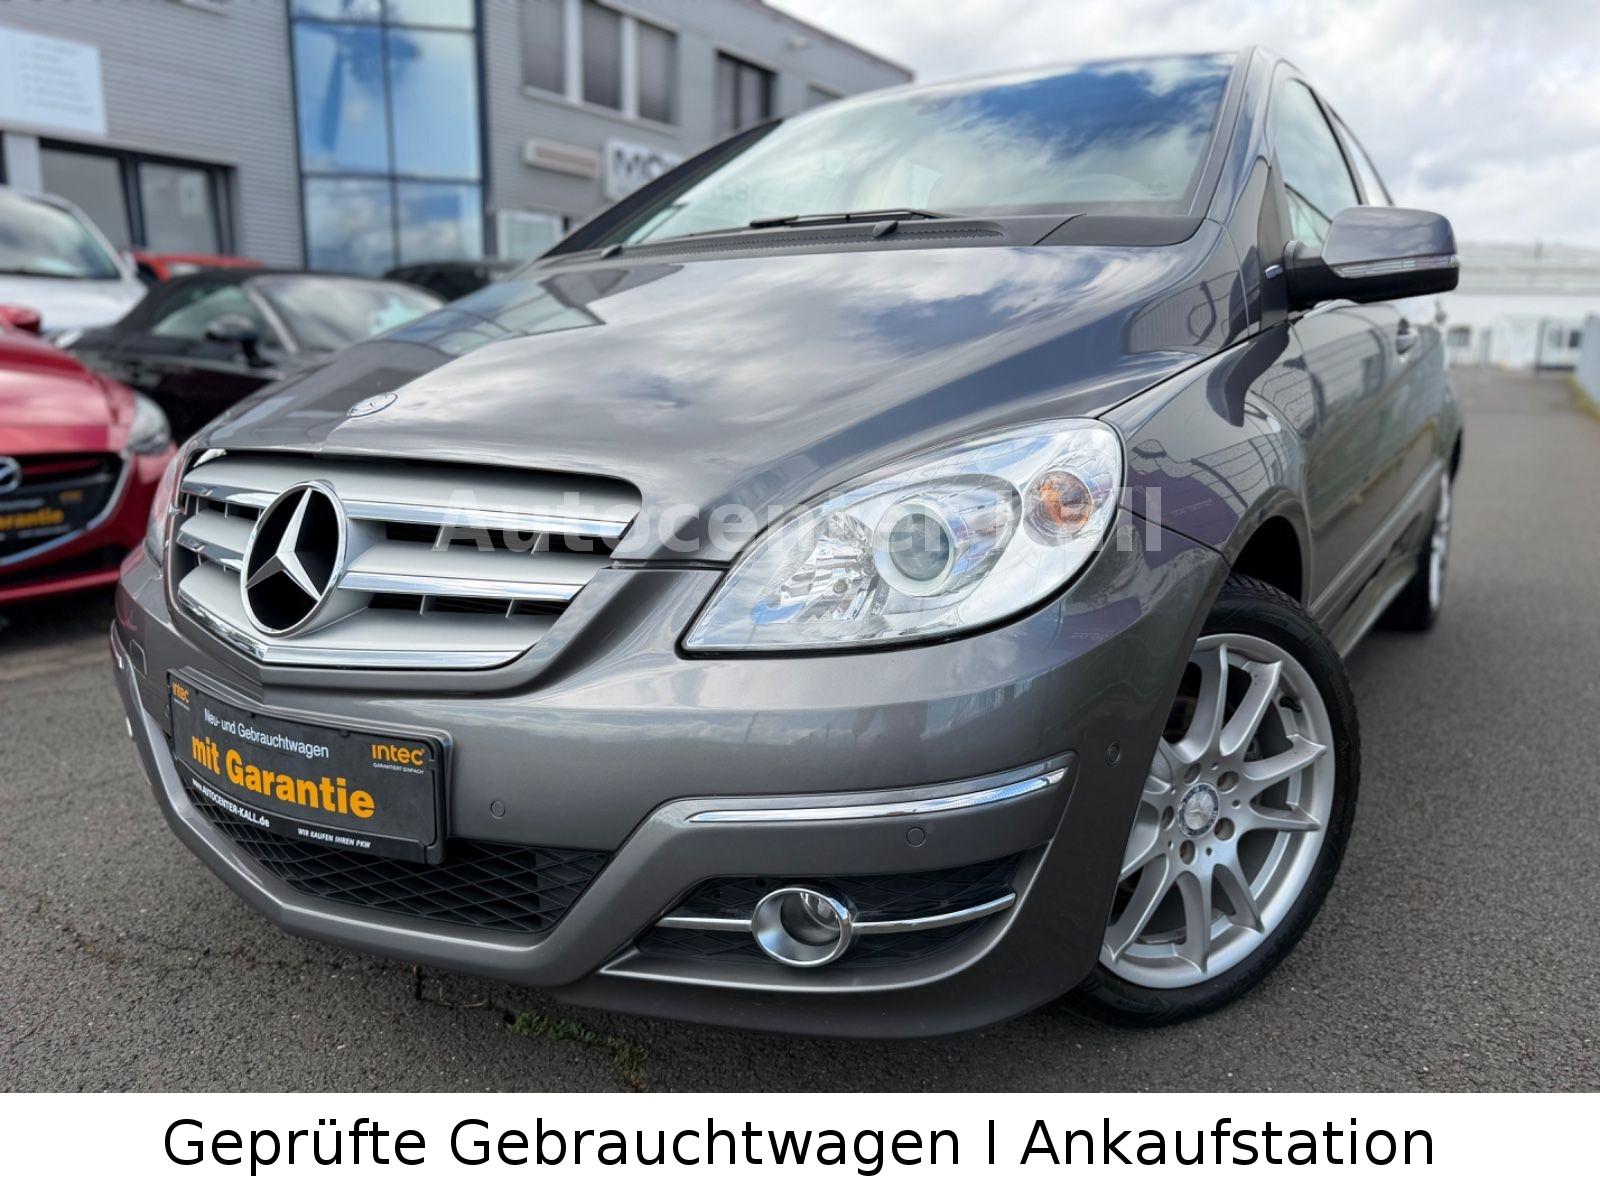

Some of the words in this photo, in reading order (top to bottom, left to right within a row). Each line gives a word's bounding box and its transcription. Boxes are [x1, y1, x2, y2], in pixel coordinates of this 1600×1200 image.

[204, 707, 220, 726] Neu-
[221, 720, 236, 735] und
[237, 722, 329, 759] Gebrauchtwagen
[372, 744, 424, 766] intec
[191, 735, 220, 775] mit
[225, 748, 375, 819] Garantie
[297, 827, 309, 837] WIR
[310, 830, 334, 842] KAUFEN
[335, 836, 355, 846] IHREN
[356, 839, 372, 849] PKW
